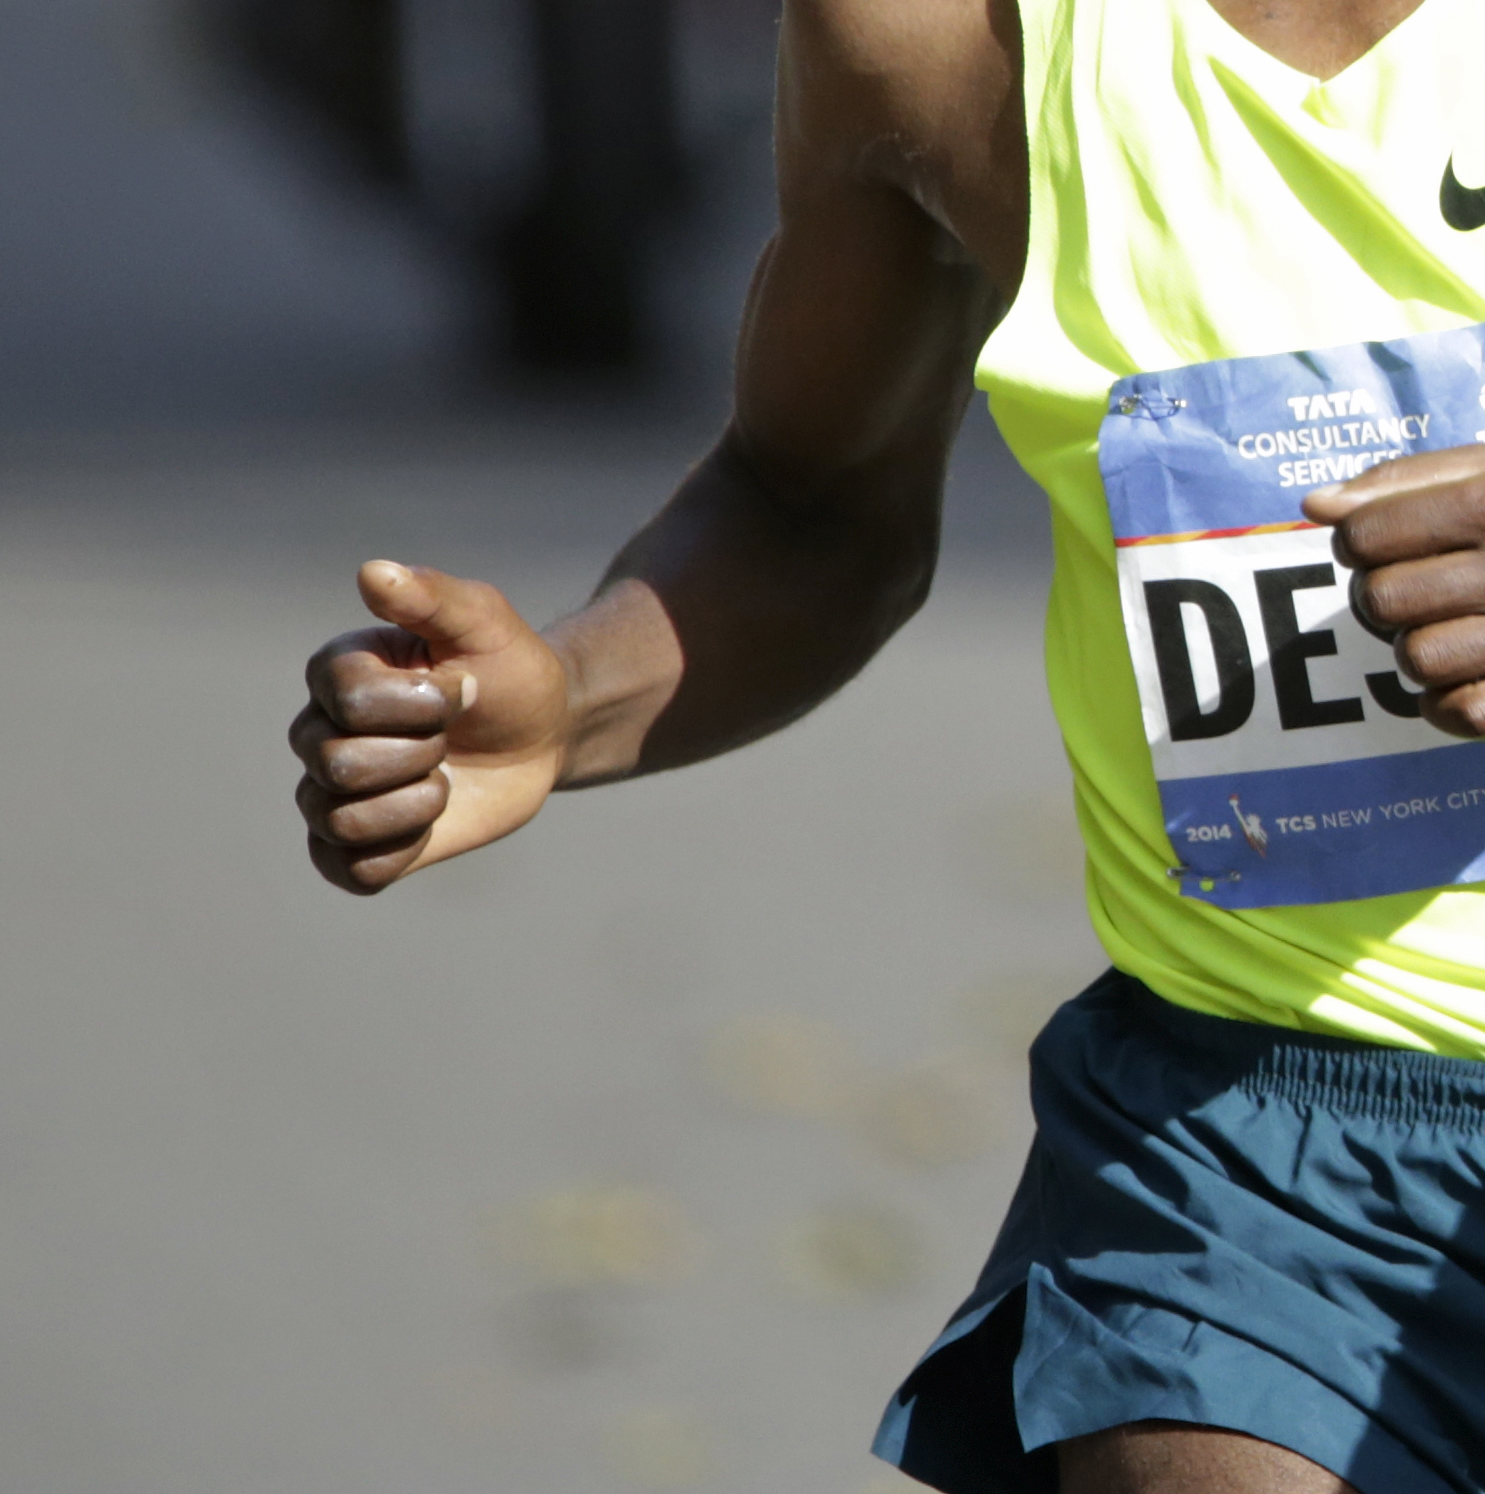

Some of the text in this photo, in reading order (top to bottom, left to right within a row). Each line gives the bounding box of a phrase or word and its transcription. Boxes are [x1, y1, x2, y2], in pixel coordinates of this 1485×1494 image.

[1286, 388, 1378, 422] TATA
[1237, 413, 1431, 460] CONSULTANCY
[1277, 449, 1403, 488] SERVIC
[1185, 824, 1232, 844] 2014
[1276, 814, 1316, 834] TCS
[1321, 808, 1373, 829] NEW
[1378, 796, 1441, 821] YORK
